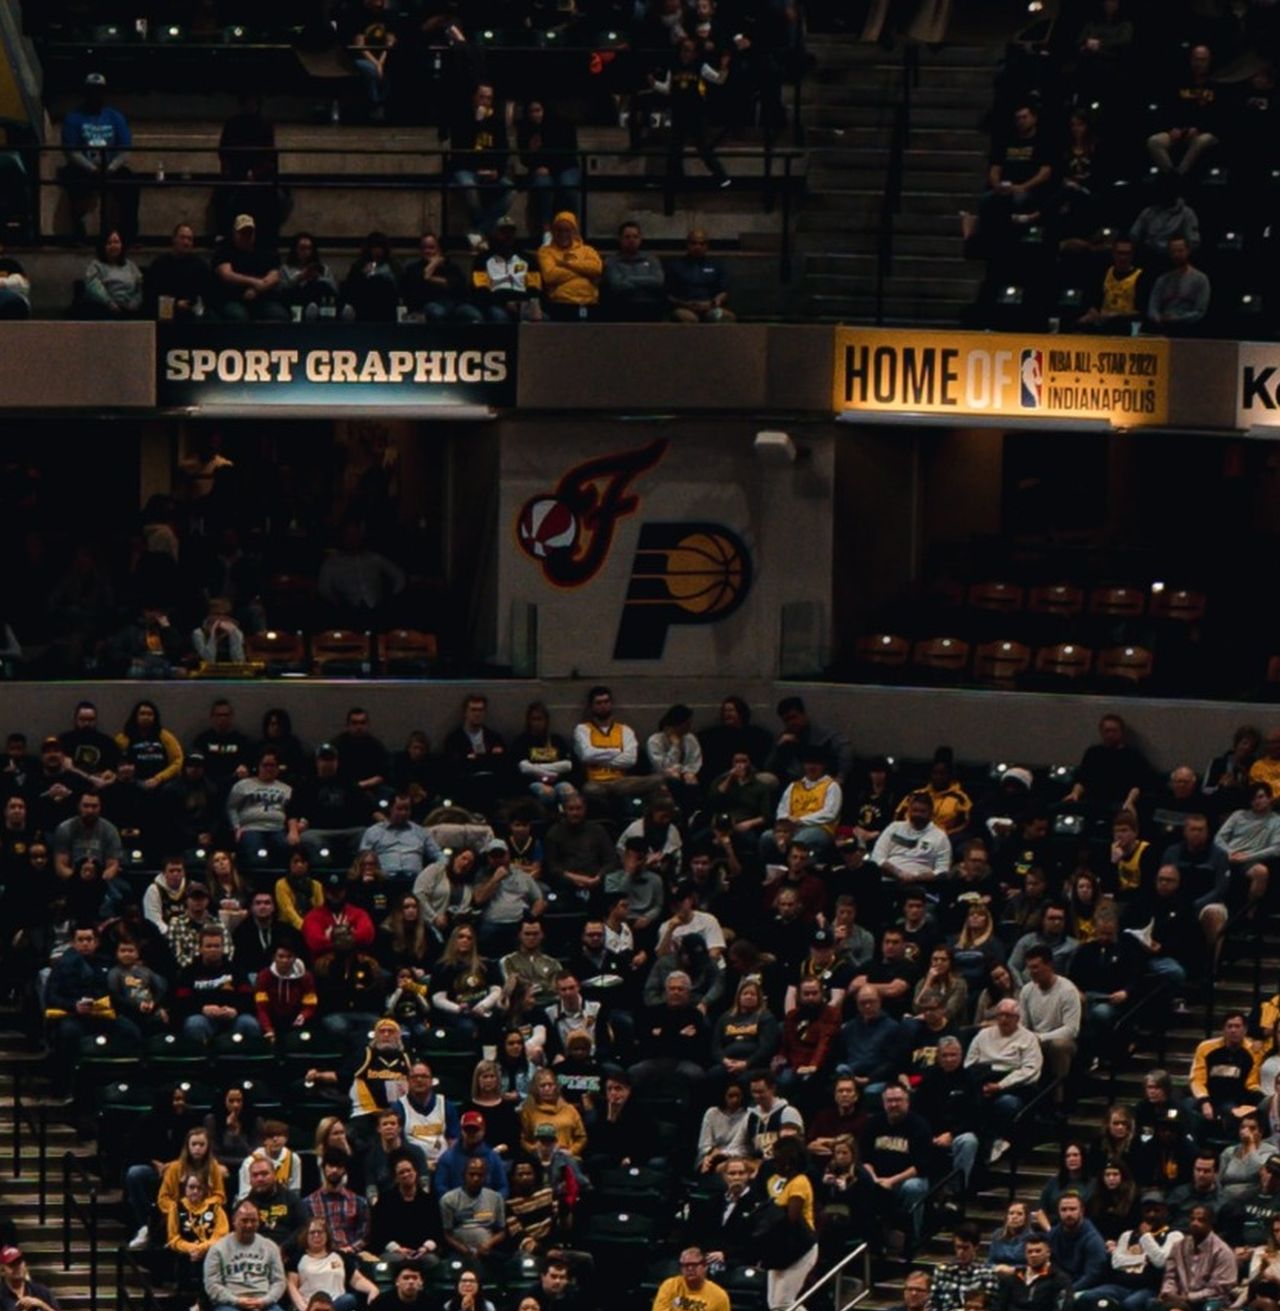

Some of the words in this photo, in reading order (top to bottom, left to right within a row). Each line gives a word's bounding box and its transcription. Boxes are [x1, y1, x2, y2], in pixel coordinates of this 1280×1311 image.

[167, 350, 298, 382] SPORT
[306, 350, 507, 383] GRAPHICS
[845, 346, 958, 405] HOME
[966, 350, 1013, 409] OF
[1049, 350, 1072, 373] NBA
[1075, 352, 1126, 374] ALL-STAR
[1129, 354, 1158, 376] 2021
[1048, 387, 1155, 413] INDIANAPOLIS
